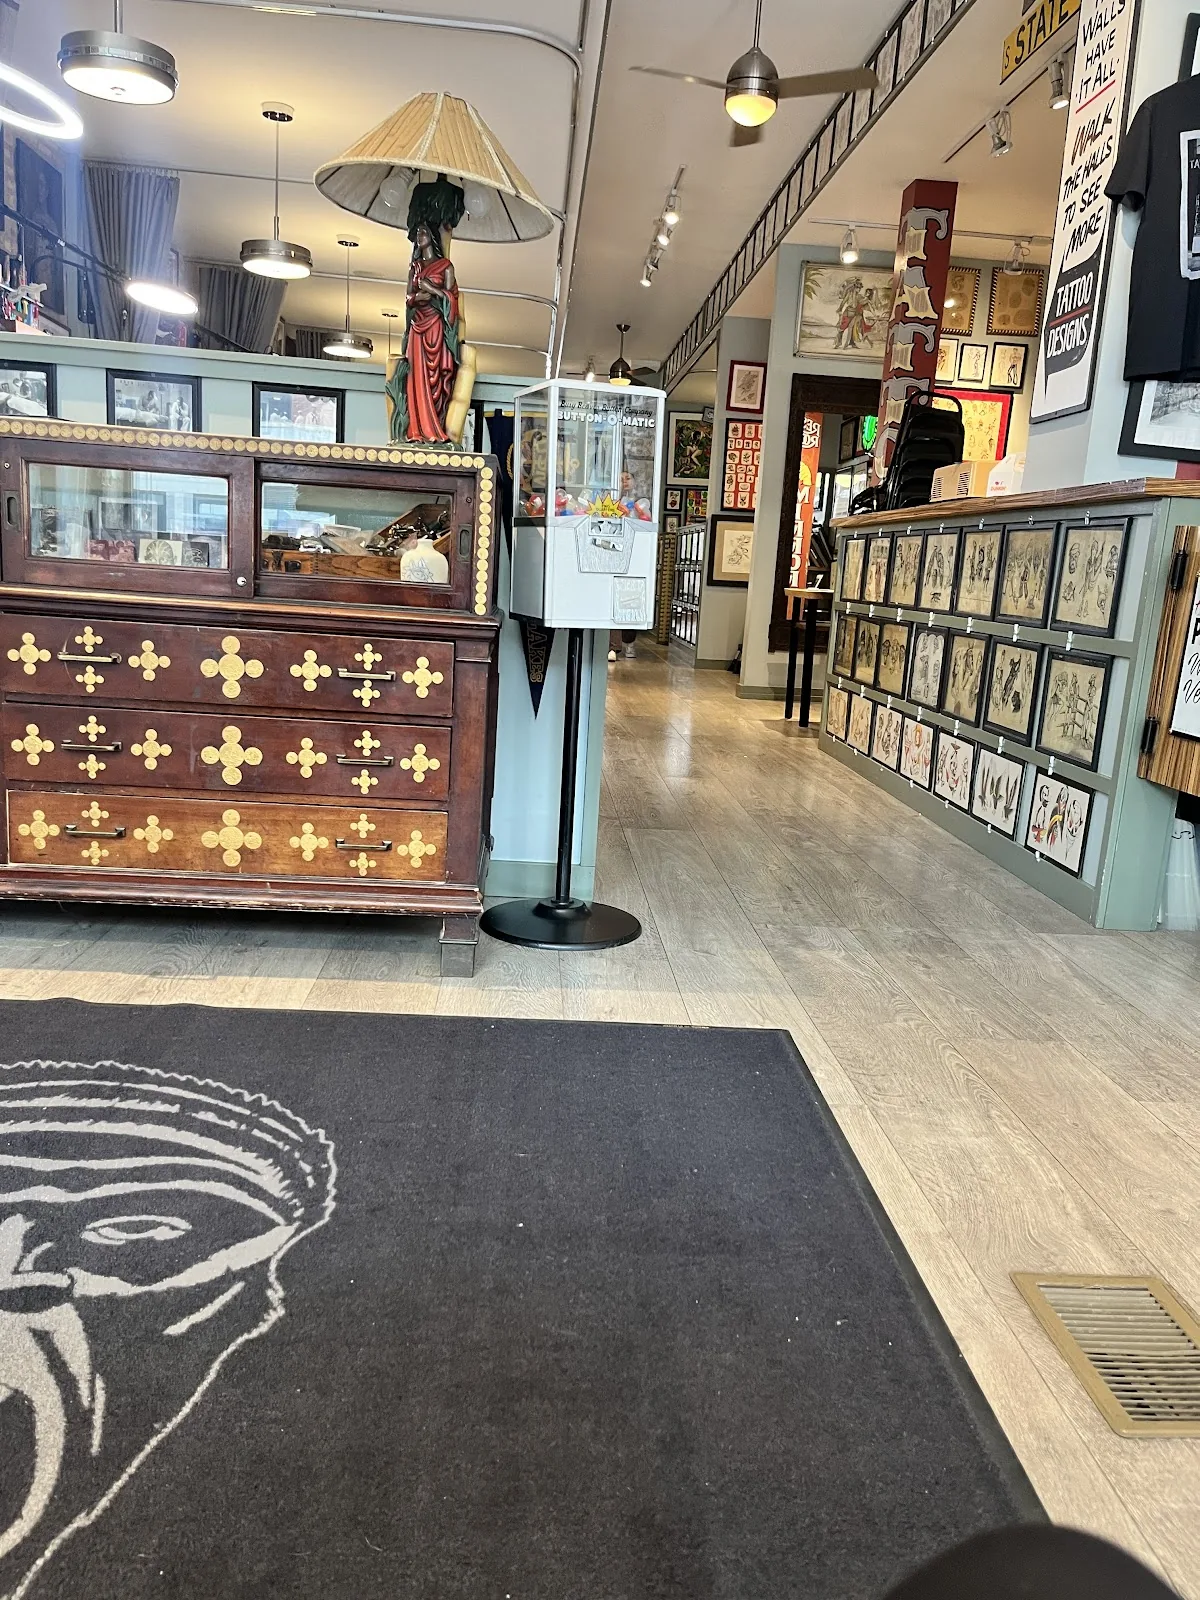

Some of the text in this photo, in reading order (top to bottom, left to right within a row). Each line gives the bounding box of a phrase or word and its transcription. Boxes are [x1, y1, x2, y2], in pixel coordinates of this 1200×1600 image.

[1082, 0, 1126, 47] WALLS
[1085, 28, 1117, 71] HAVE
[1070, 97, 1116, 166] WALK
[1063, 134, 1114, 203] THE HALLS
[1063, 175, 1103, 231] TO SEE
[1065, 205, 1104, 261] MORE
[1055, 271, 1094, 318] TATTOO
[1046, 313, 1090, 359] DESIGNS
[624, 406, 653, 417] Company
